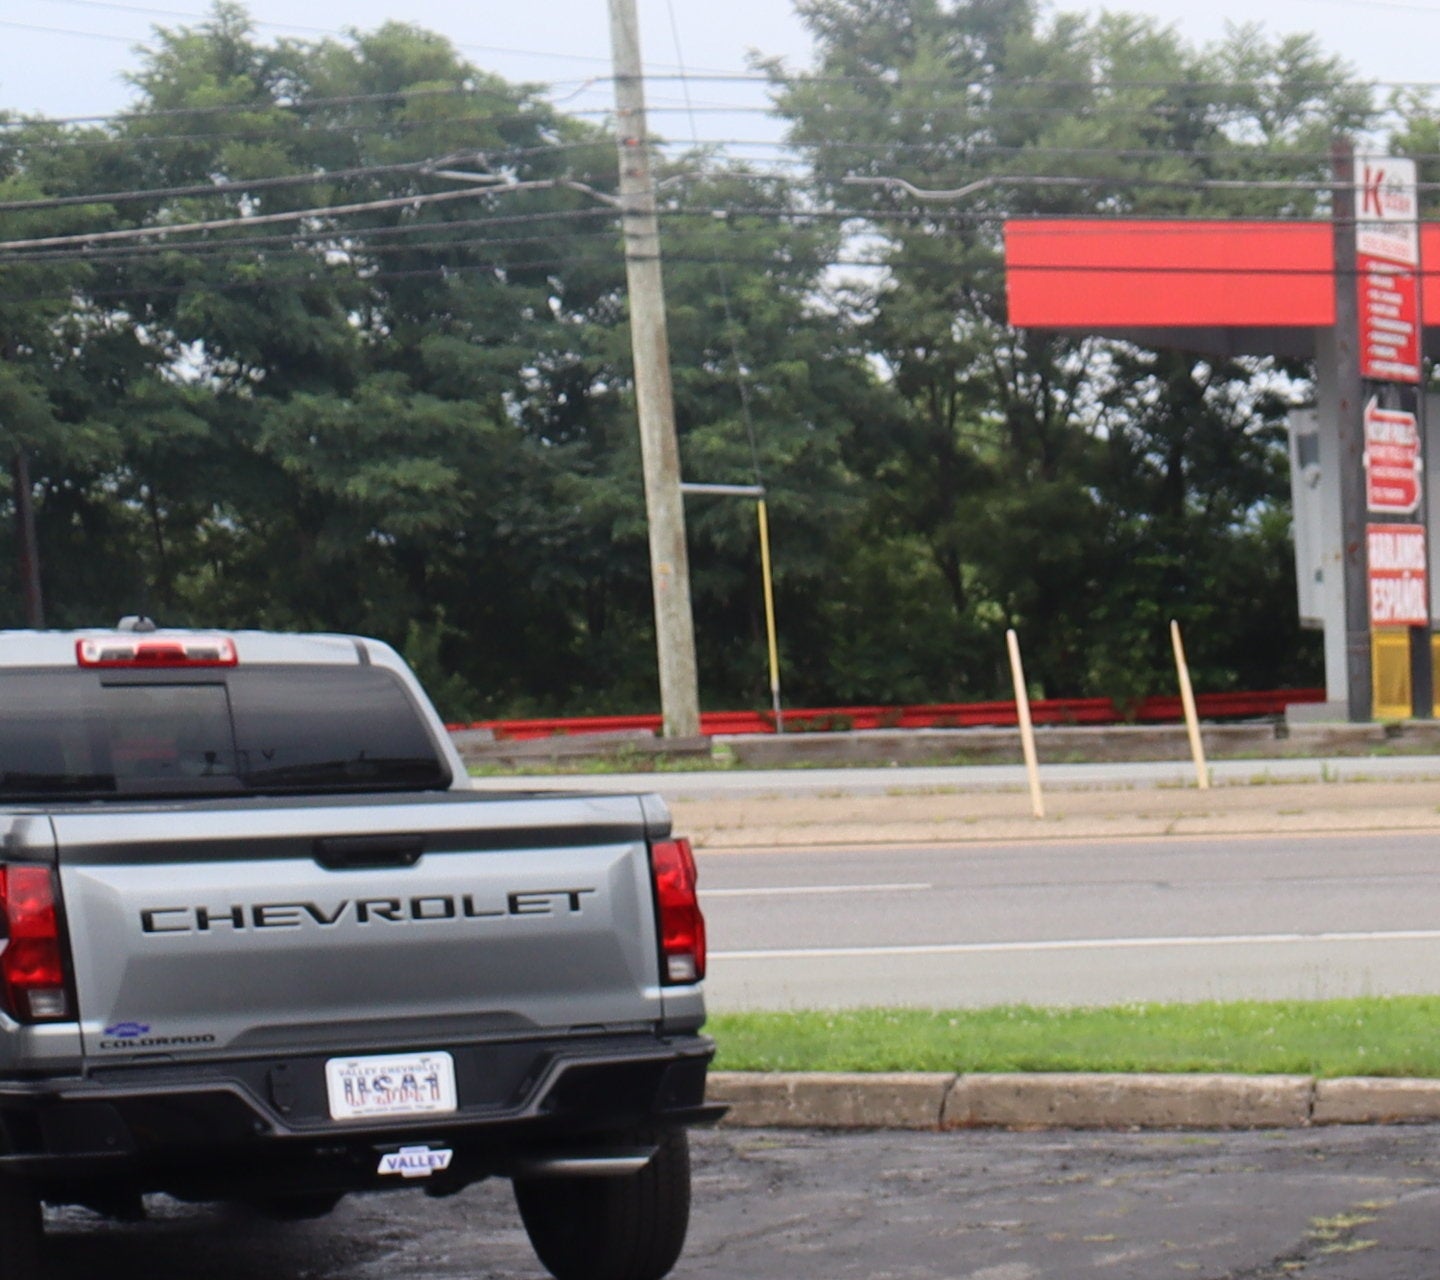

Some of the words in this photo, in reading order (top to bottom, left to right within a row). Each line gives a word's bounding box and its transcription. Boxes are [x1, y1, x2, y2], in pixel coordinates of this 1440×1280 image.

[139, 887, 596, 933] CHEVROLET
[100, 1033, 215, 1049] COLORADO
[387, 1154, 447, 1169] VALLEY
